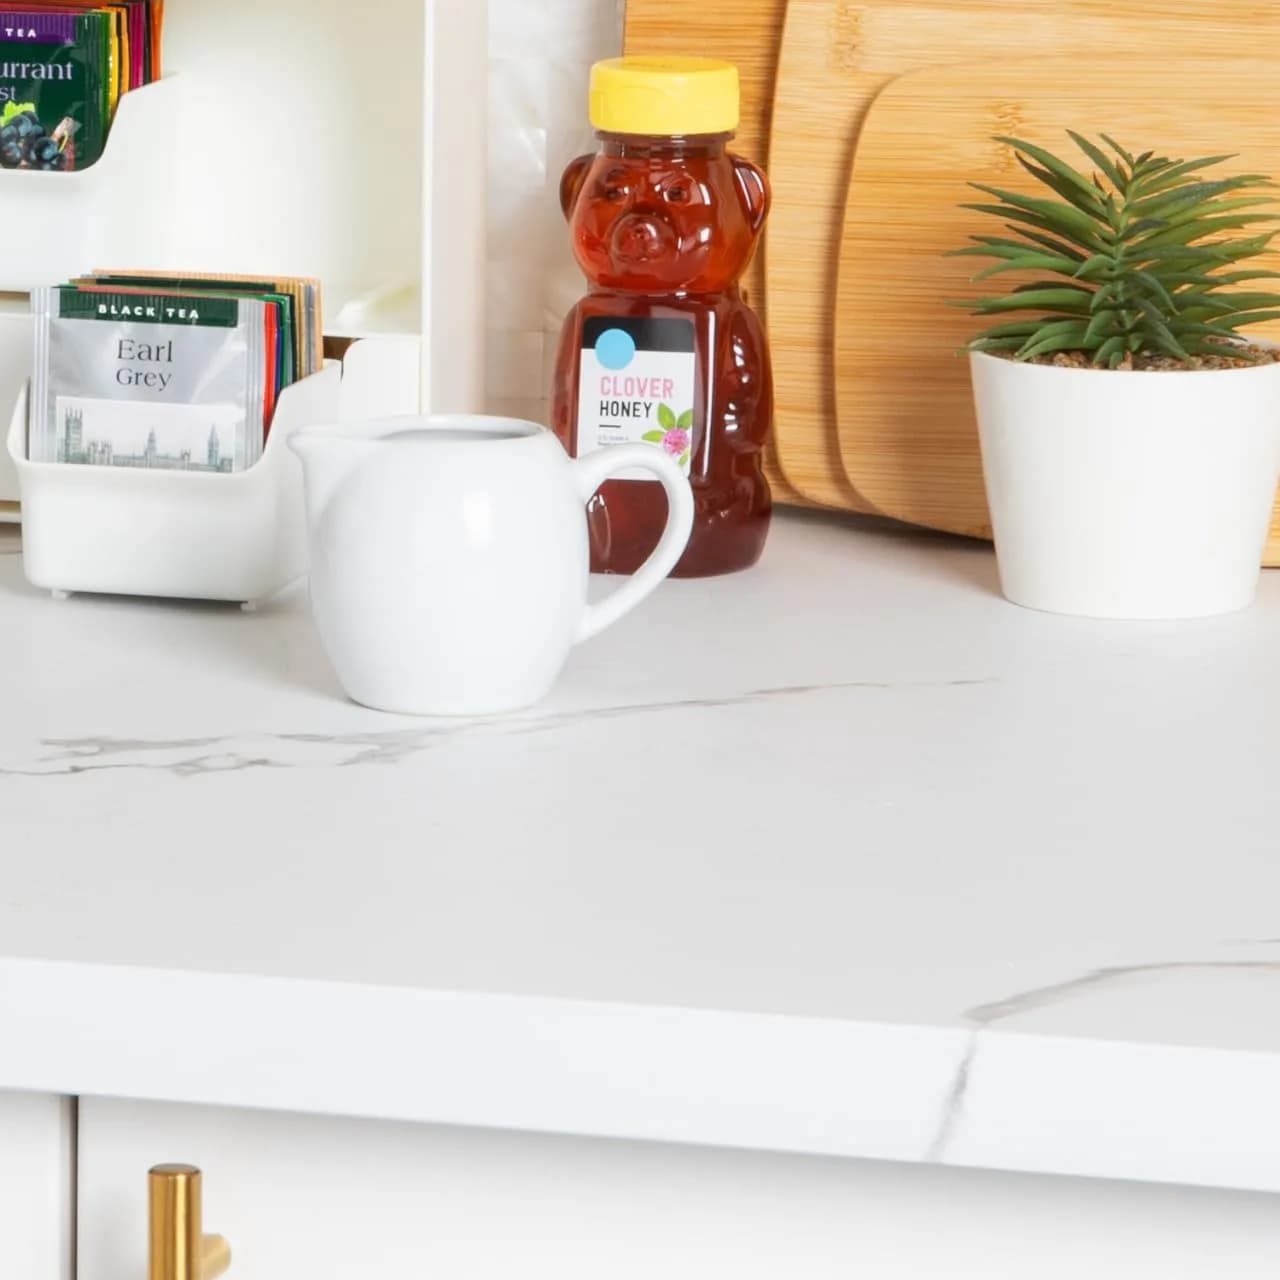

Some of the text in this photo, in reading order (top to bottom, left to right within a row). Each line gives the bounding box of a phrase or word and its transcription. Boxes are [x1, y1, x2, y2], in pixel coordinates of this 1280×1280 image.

[5, 28, 37, 37] TEA
[98, 305, 199, 319] BLACK TEA
[117, 339, 173, 362] Earl
[116, 368, 172, 391] Grey
[600, 376, 674, 398] CLOVER
[600, 400, 652, 418] HONEY
